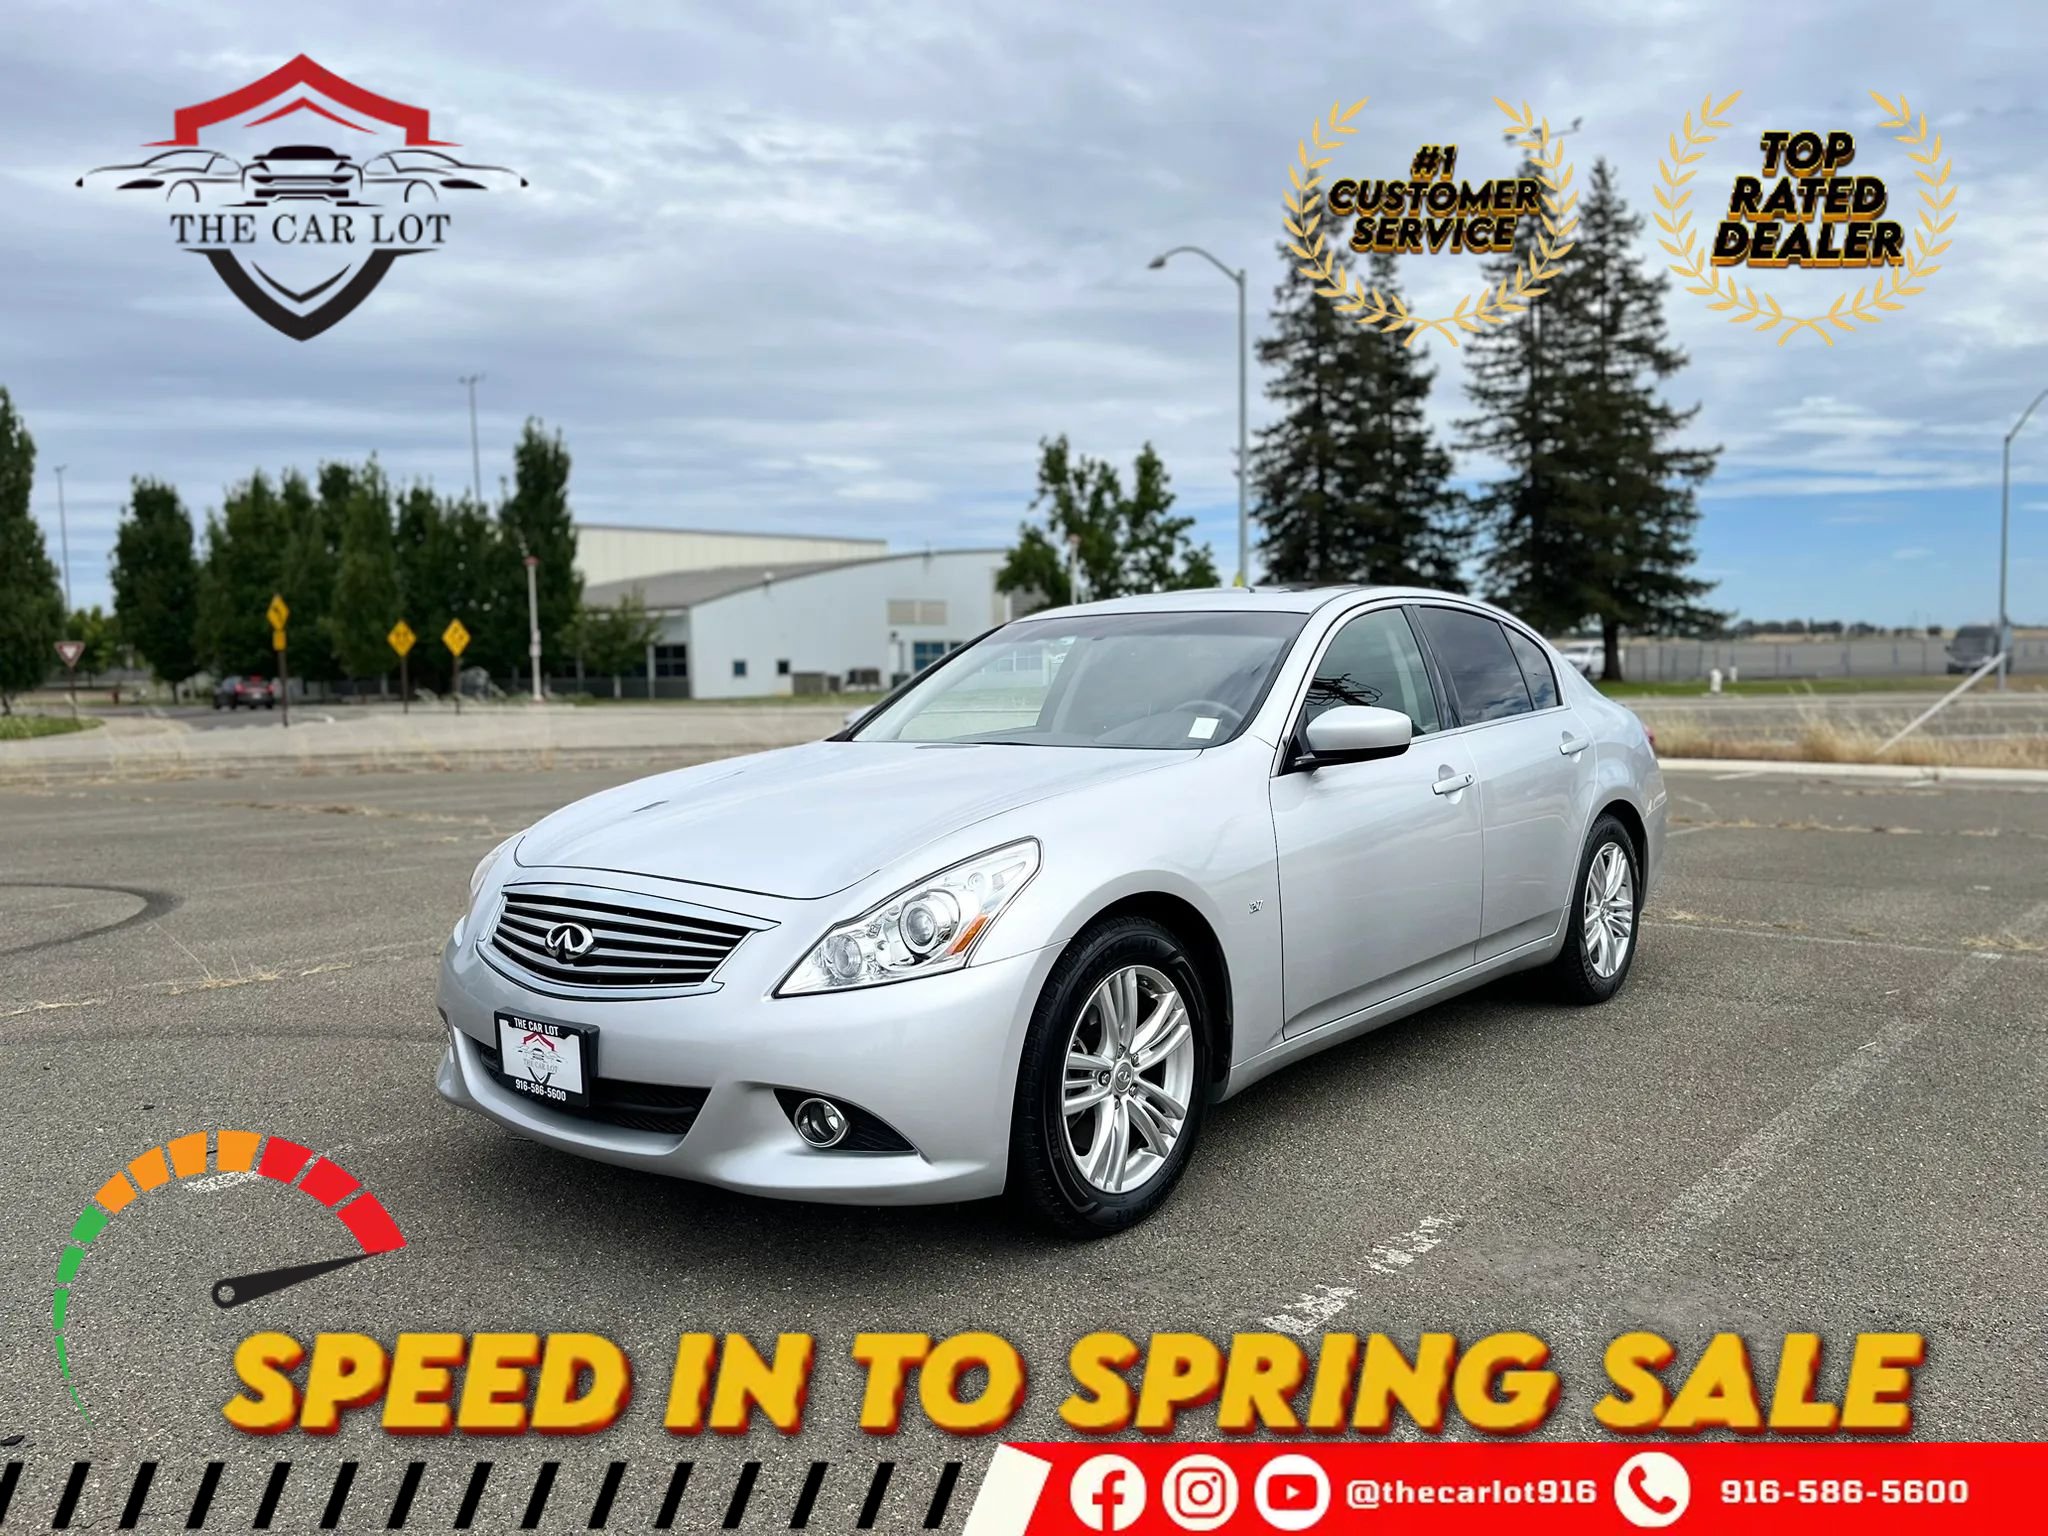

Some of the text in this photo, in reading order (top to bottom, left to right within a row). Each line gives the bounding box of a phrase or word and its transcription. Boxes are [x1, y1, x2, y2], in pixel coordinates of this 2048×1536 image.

[514, 1018, 558, 1036] THE CAR LOT
[516, 1079, 566, 1101] 916-586-5600
